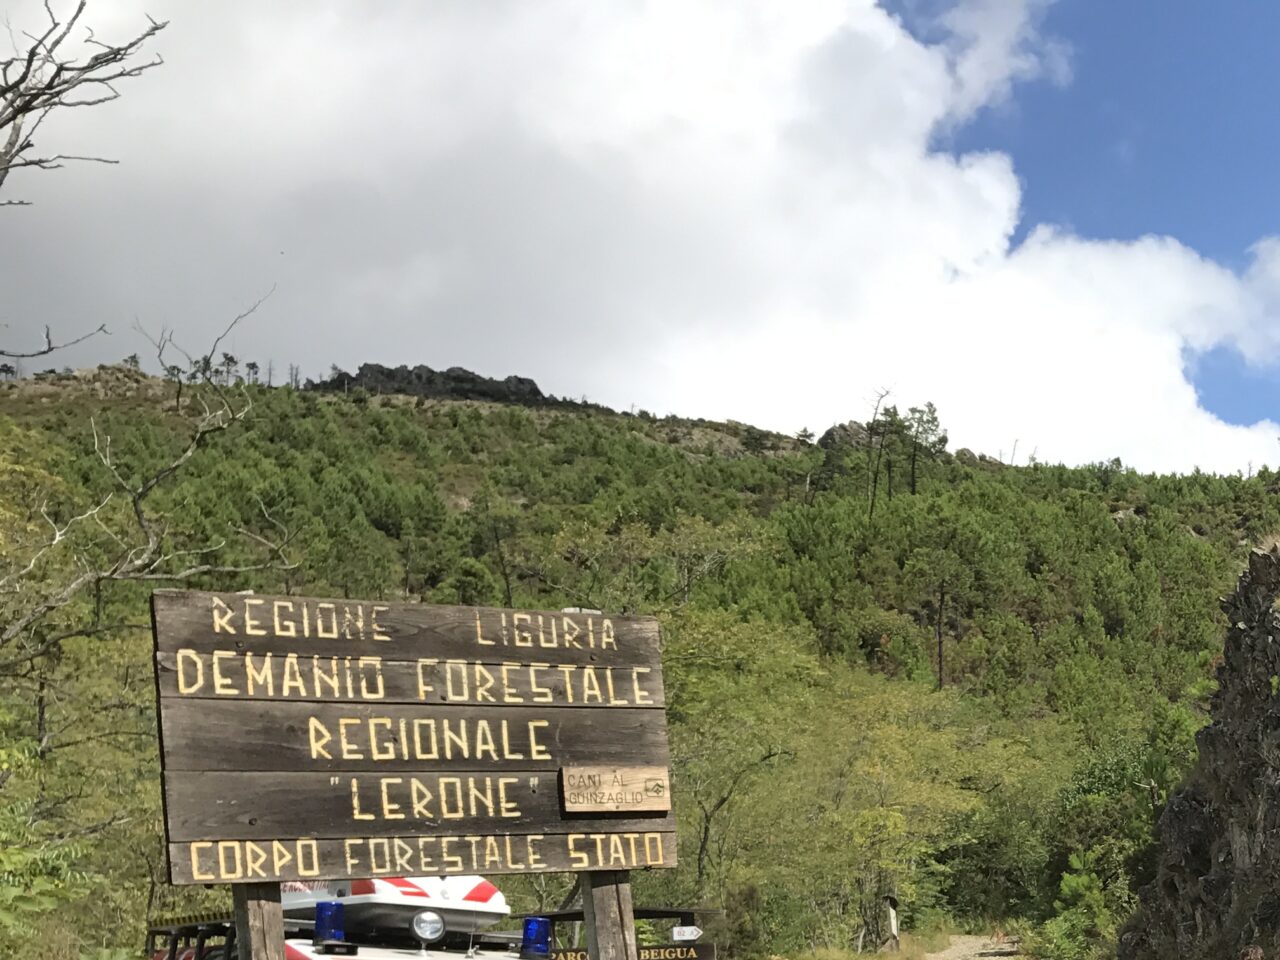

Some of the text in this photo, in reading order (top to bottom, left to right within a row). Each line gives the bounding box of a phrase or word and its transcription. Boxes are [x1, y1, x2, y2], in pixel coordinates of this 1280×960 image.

[212, 596, 618, 651] REGIONE LIGURIA
[177, 648, 654, 706] DEMANIO FORESTALE
[308, 716, 553, 761] REGIONALE
[567, 774, 628, 787] CANI AL
[569, 792, 644, 804] GUINZAGLIO
[190, 831, 665, 881] CORPO FORESTALE STATO
[640, 948, 698, 960] BEIGUA
